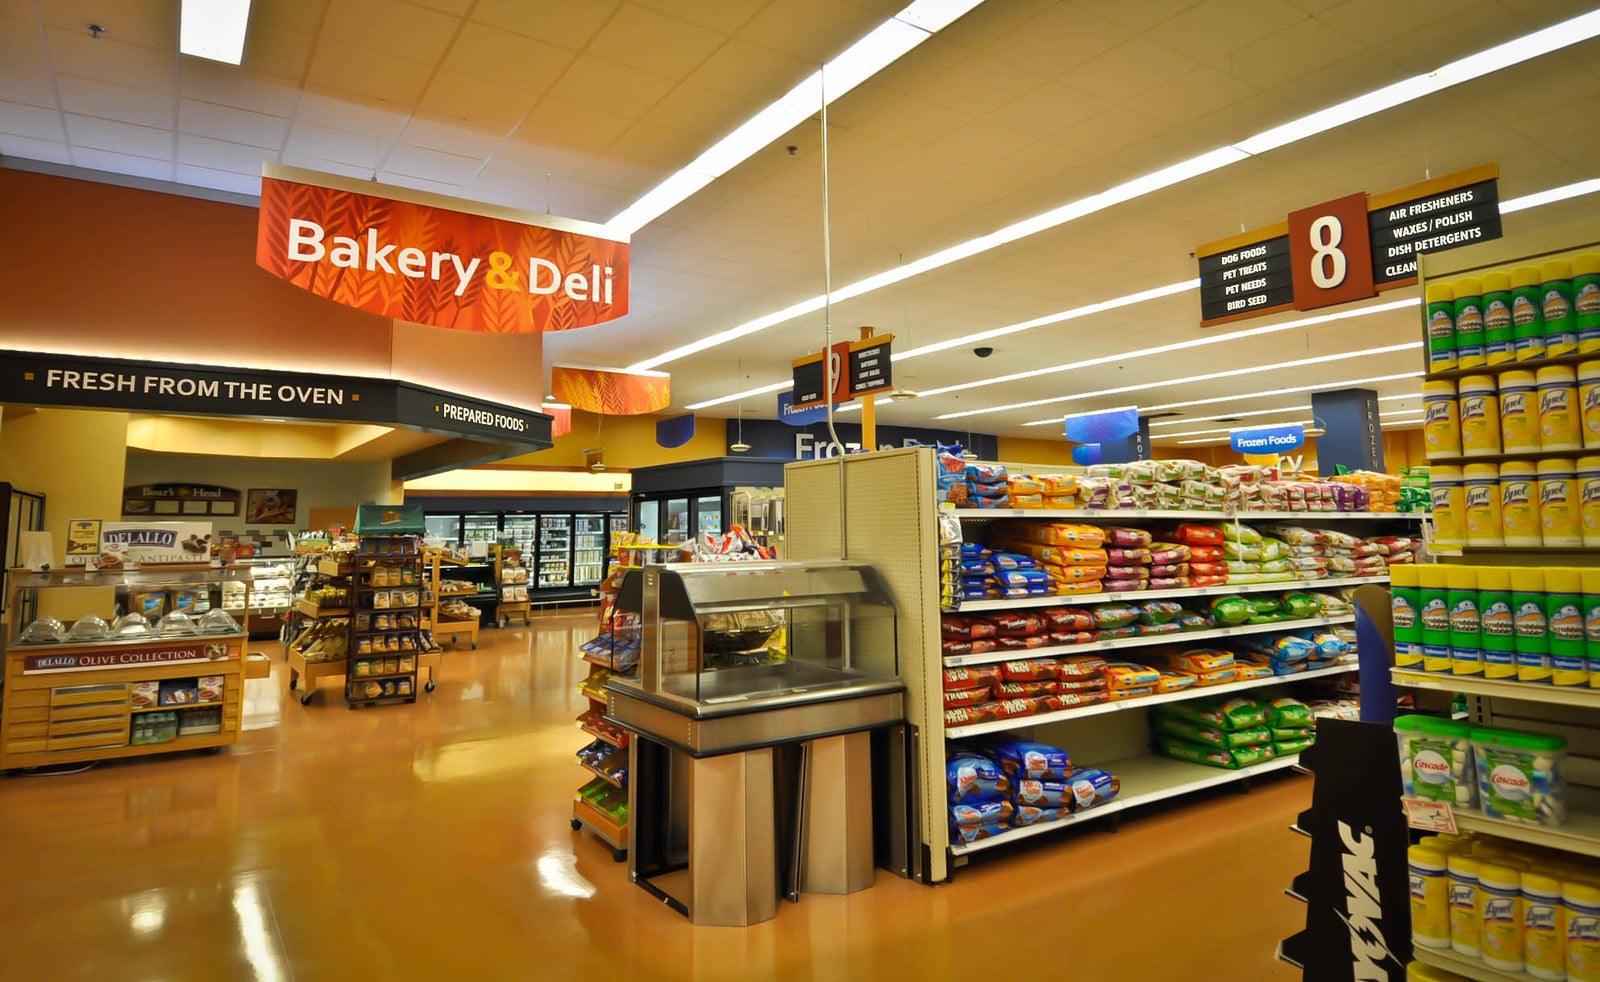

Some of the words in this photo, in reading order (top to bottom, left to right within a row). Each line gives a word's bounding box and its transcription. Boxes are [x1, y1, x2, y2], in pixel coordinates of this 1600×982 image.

[1389, 208, 1407, 221] AIR
[1409, 190, 1474, 216] FRESHENERS
[1392, 221, 1428, 239] WAXES
[1435, 210, 1473, 229] POLISH
[1309, 215, 1347, 289] 8
[1388, 243, 1412, 258] DISH
[1414, 227, 1482, 252] DETERGENTS
[287, 218, 481, 297] Bakery
[485, 250, 522, 293] &
[529, 257, 614, 305] Deli
[1221, 255, 1238, 265] DOG
[1240, 245, 1267, 260] FOODS
[1222, 269, 1237, 281] PET
[1239, 262, 1267, 276] TREATS
[1225, 285, 1240, 296] PET
[1241, 277, 1267, 292] NEEDS
[1226, 300, 1246, 312] BIRD
[1247, 294, 1267, 307] SEED
[830, 353, 841, 396] 9
[46, 369, 136, 393] FRESH
[143, 376, 219, 398] FROM
[223, 381, 273, 401] THE
[277, 385, 344, 405] OVEN
[1541, 391, 1566, 411] Lysol
[443, 403, 494, 425] PREPARED
[495, 414, 524, 432] FOODS
[1237, 437, 1268, 448] Frozen
[1269, 434, 1297, 445] Foods
[1503, 484, 1527, 503] Lysol
[1541, 483, 1565, 502] Lysol
[109, 532, 173, 544] DELALLO
[79, 655, 117, 666] OLIVE
[120, 650, 196, 663] COLLECTION
[1414, 759, 1449, 772] Cascade
[1491, 773, 1529, 788] Cascade
